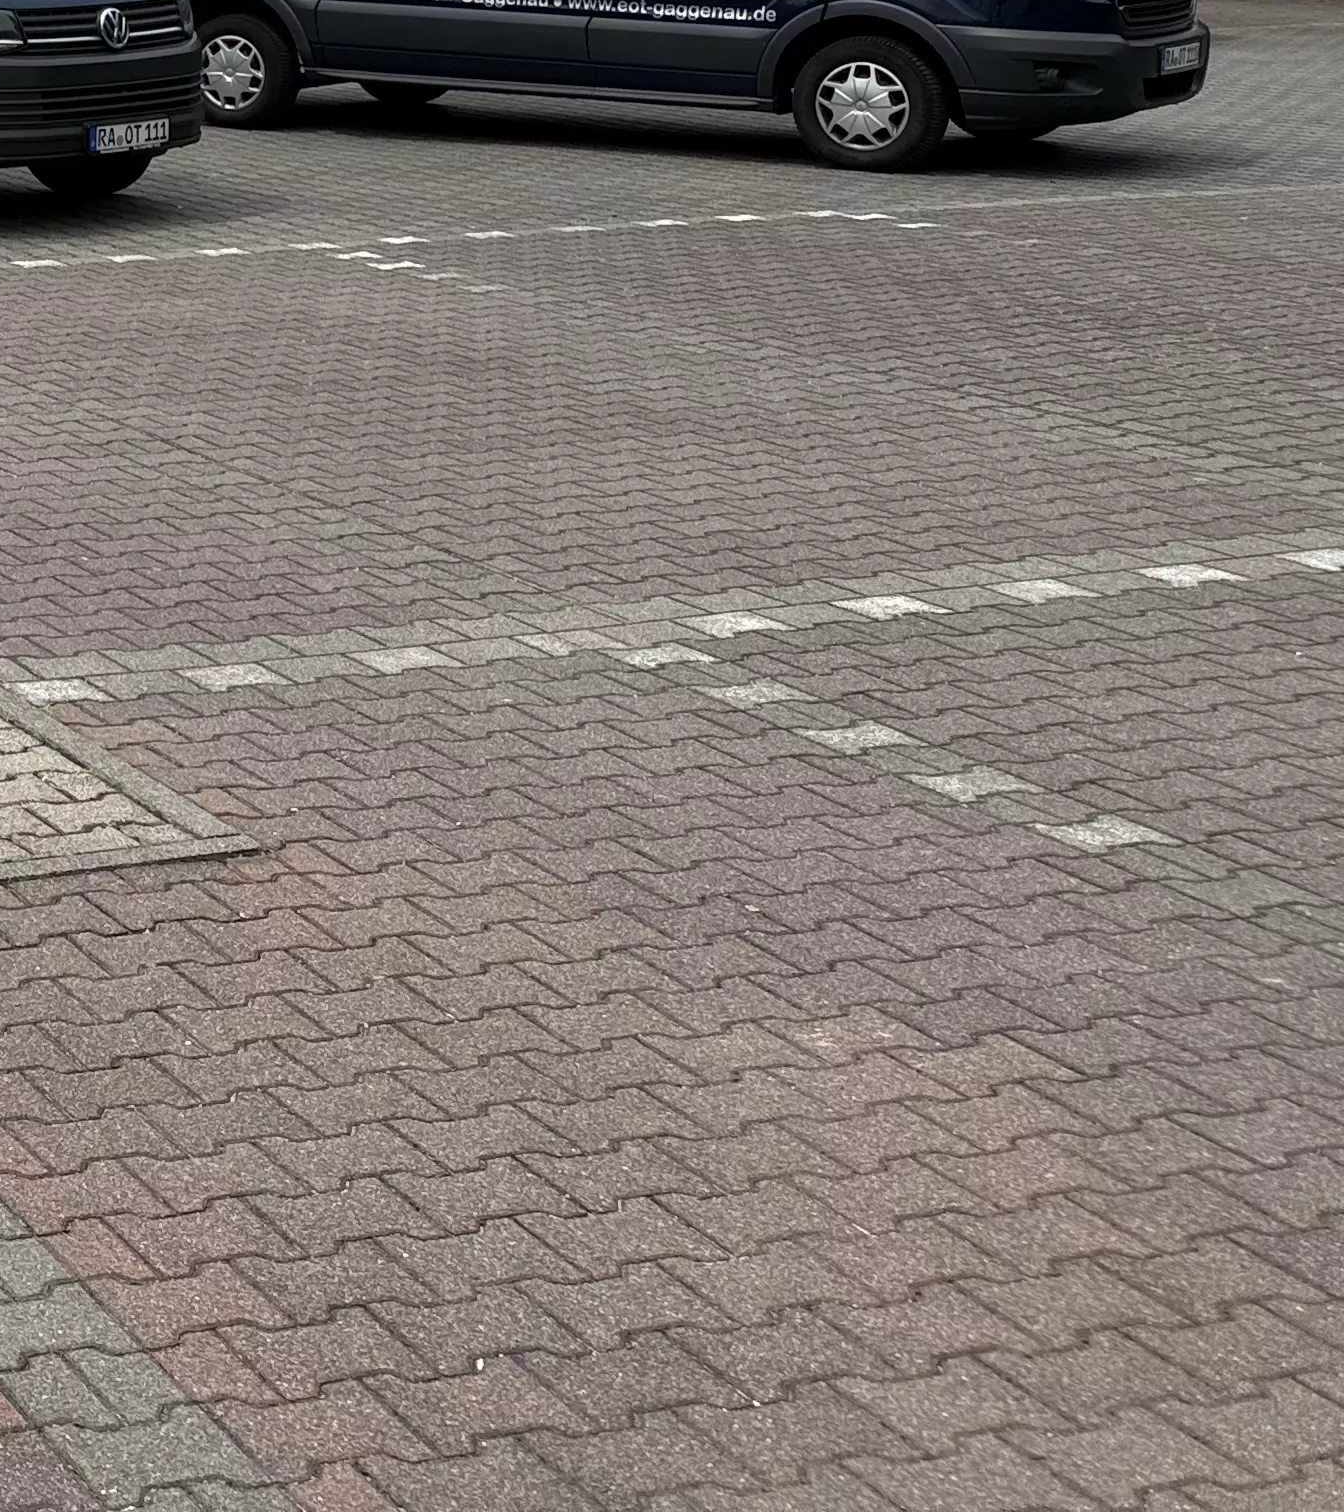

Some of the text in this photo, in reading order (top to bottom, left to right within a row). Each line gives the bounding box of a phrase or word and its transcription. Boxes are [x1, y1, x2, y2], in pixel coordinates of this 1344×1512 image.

[98, 121, 167, 147] RA OT 111
